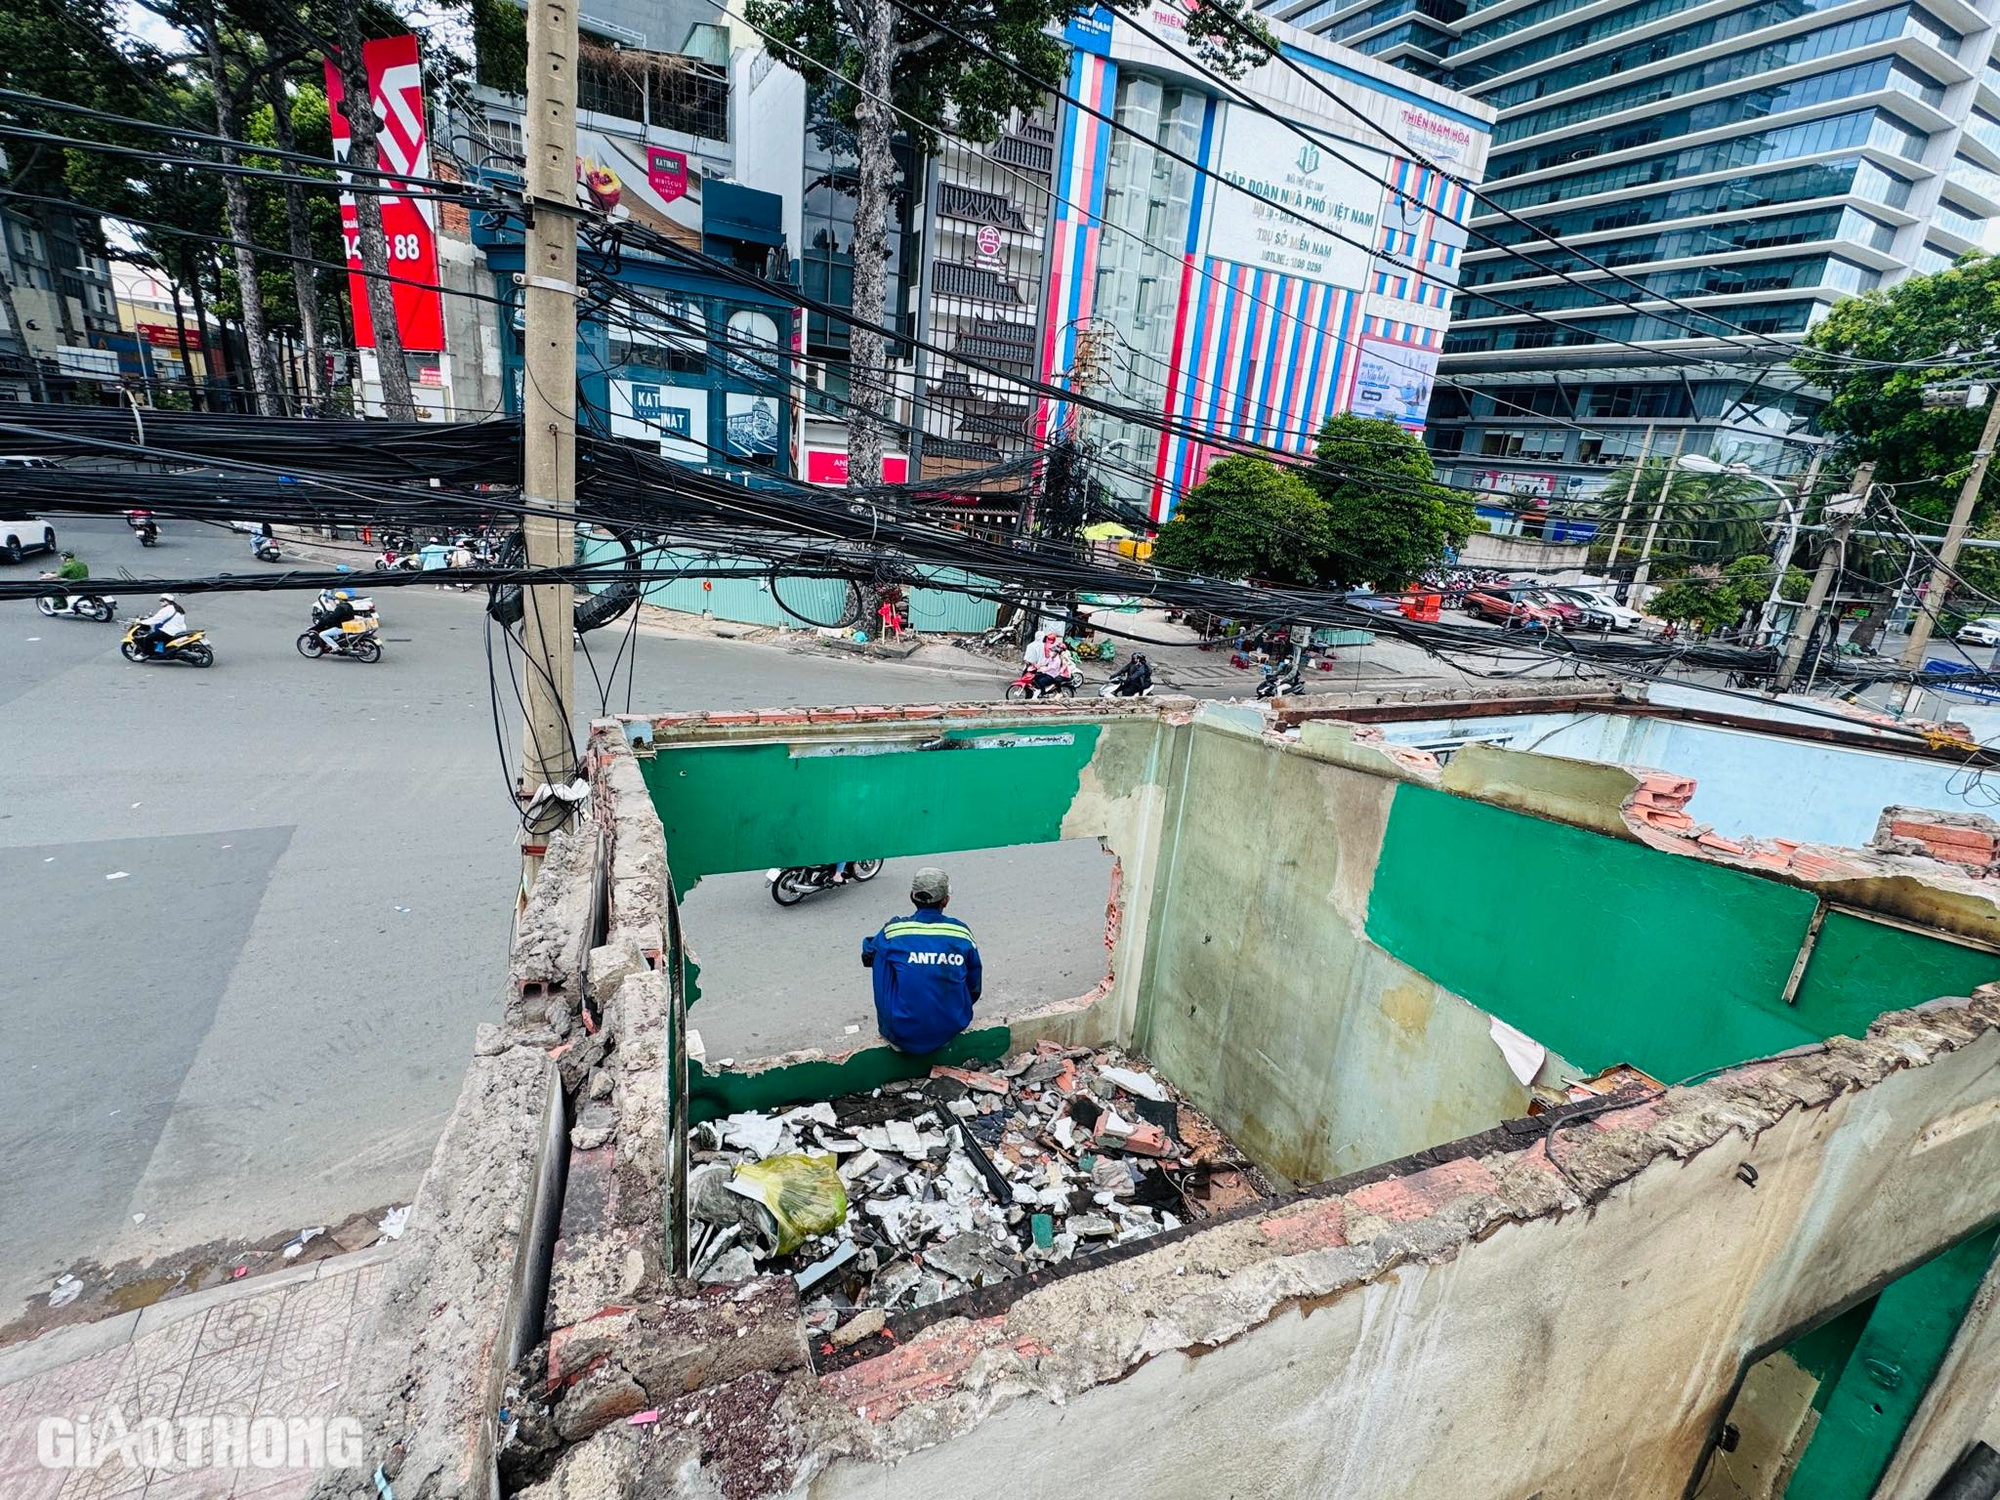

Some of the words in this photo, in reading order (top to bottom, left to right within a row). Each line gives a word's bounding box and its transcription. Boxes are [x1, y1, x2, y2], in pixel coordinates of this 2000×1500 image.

[1304, 194, 1327, 213] PHỐ
[1350, 208, 1374, 227] NAM
[394, 233, 420, 260] 88
[1311, 242, 1333, 259] NAM
[638, 391, 660, 408] KAT
[907, 951, 964, 966] ANTACO
